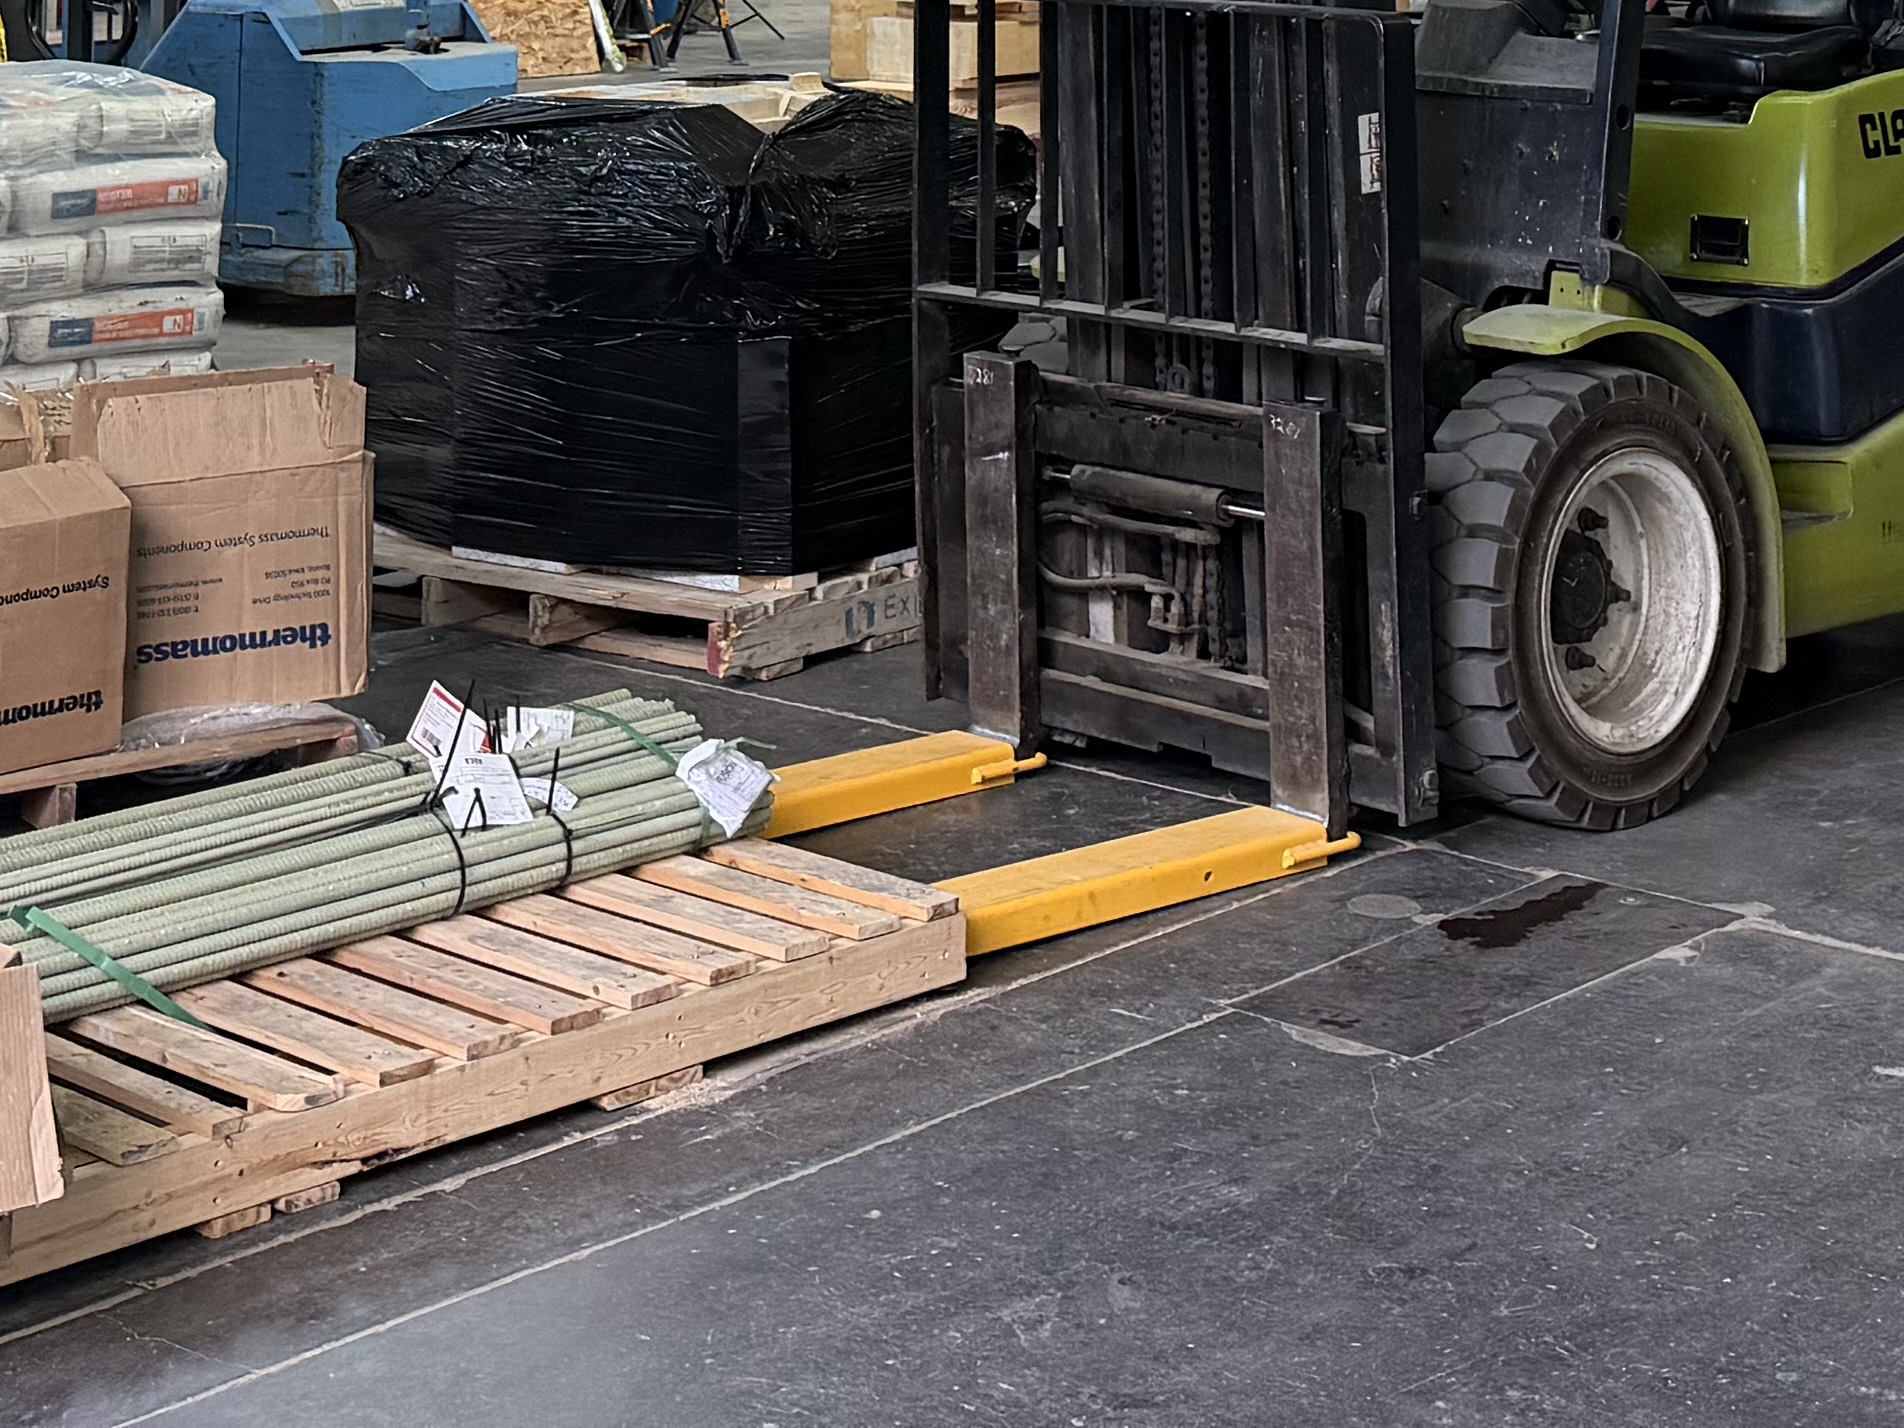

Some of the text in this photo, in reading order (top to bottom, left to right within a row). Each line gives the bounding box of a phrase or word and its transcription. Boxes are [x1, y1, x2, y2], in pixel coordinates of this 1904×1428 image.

[136, 540, 212, 560] Components
[214, 532, 256, 550] System
[62, 574, 110, 595] System
[136, 622, 332, 665] thermomass
